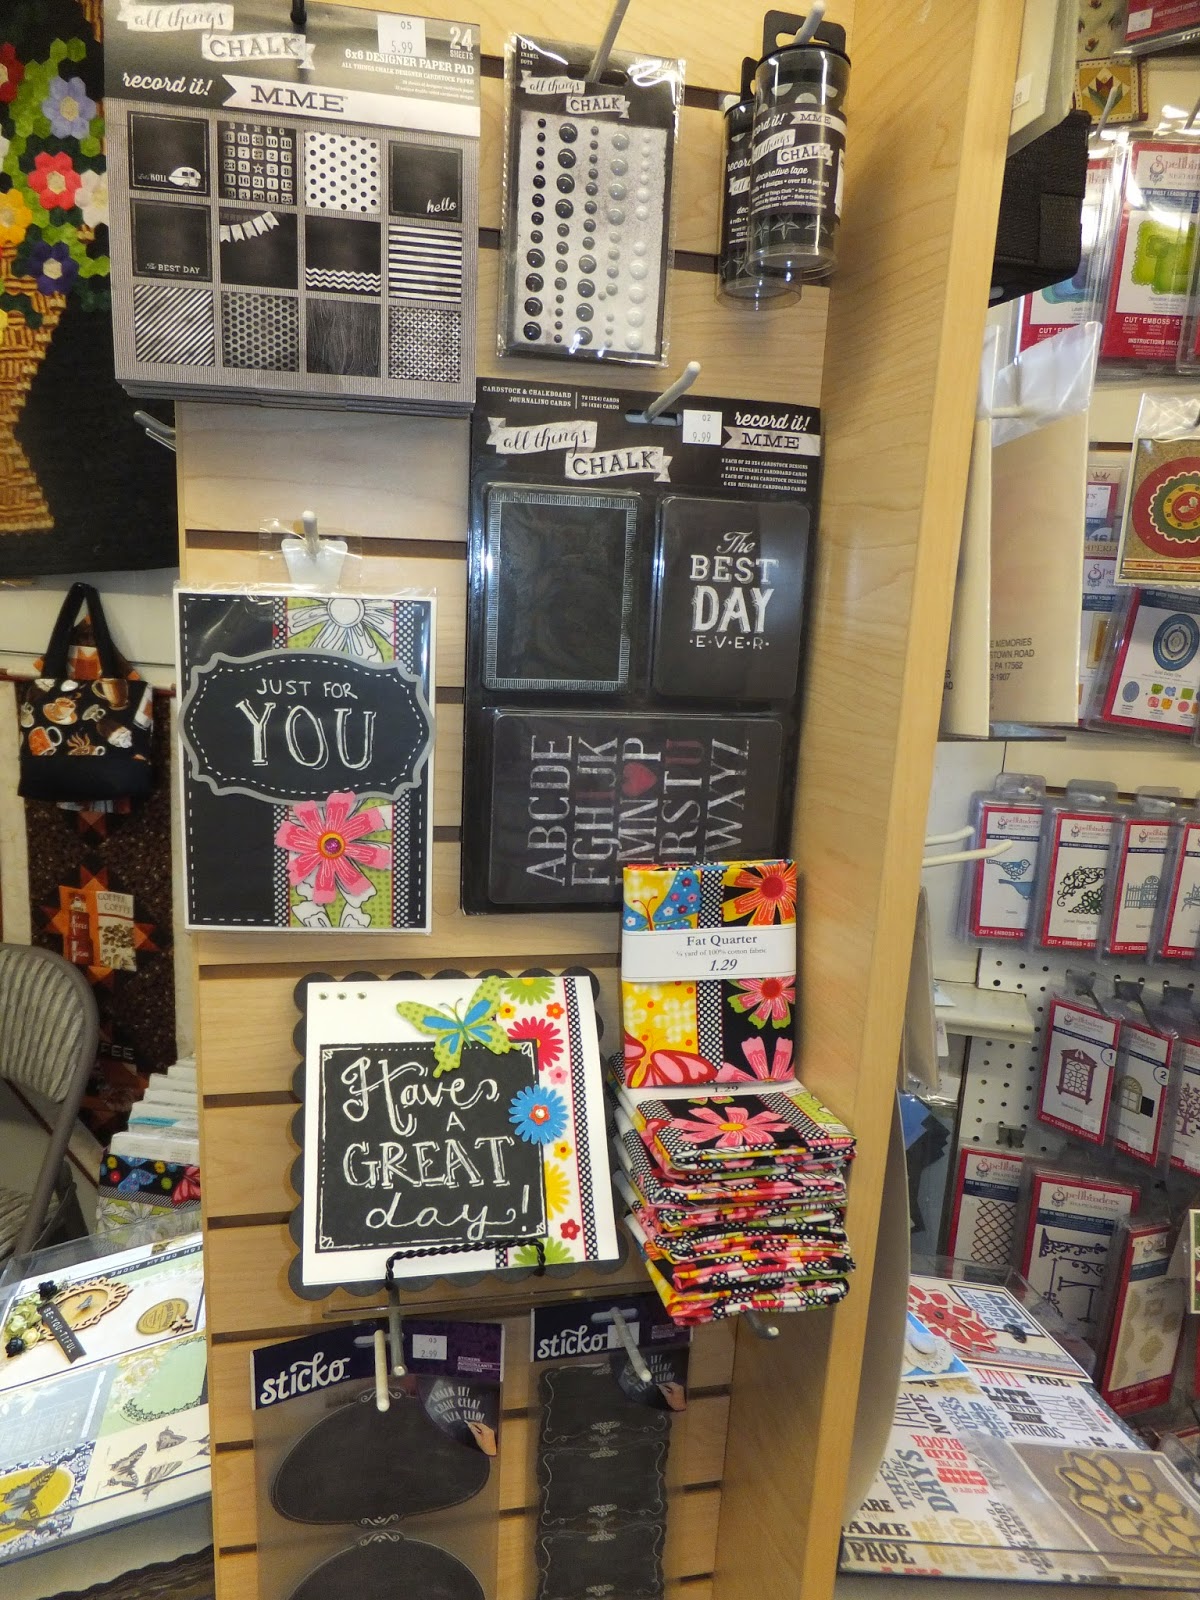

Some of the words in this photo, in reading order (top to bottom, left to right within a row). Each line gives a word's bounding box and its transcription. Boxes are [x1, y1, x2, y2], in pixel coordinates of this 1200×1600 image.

[134, 11, 162, 27] all
[167, 5, 225, 38] things
[400, 20, 412, 30] 05
[208, 36, 297, 59] CHALK
[391, 40, 414, 54] 5.99
[449, 26, 474, 52] 24
[344, 48, 364, 60] 6x6
[366, 51, 417, 67] DESIGNER
[420, 58, 452, 73] PAPER
[454, 63, 474, 75] PAD
[449, 49, 474, 60] SHEETS
[122, 72, 187, 94] record
[188, 78, 214, 96] it!
[354, 63, 374, 72] THINGS
[374, 66, 394, 74] CHALK
[395, 68, 423, 78] DESIGNER
[423, 72, 455, 82] CARDSTOCK
[456, 78, 474, 86] PAPER
[529, 79, 544, 92] all
[548, 76, 580, 98] things
[250, 85, 345, 114] MME
[570, 97, 621, 112] CHALK
[800, 113, 832, 124] MME
[790, 166, 808, 176] tape
[426, 198, 458, 214] hello
[158, 264, 181, 274] BEST
[183, 265, 201, 274] DAY
[1142, 316, 1171, 325] EMBOSS
[1128, 338, 1166, 346] INSTRUCTIONS
[482, 386, 521, 394] CARDSTOCK
[528, 389, 572, 398] CHALKBOARD
[508, 396, 549, 406] JOURNALING
[735, 411, 788, 429] record
[792, 414, 812, 431] it!
[503, 430, 530, 448] all
[534, 427, 590, 458] things
[692, 431, 712, 444] 9.99
[742, 432, 800, 450] MME
[572, 450, 655, 477] CHALK
[716, 531, 756, 554] The
[690, 555, 779, 584] BEST
[691, 585, 774, 634] DAY
[995, 638, 1032, 648] MEMORIES
[1014, 649, 1035, 658] ROAD
[994, 662, 1002, 670] PA
[256, 678, 312, 696] JUST
[323, 682, 358, 700] FOR
[235, 698, 377, 770] YOU
[687, 935, 706, 946] Fat
[710, 934, 758, 946] Quarter
[708, 958, 738, 972] 1.29
[340, 1056, 500, 1137] Have
[446, 1111, 466, 1132] A
[342, 1136, 516, 1190] GREAT
[1056, 1186, 1120, 1206] Spellbinders
[365, 1184, 530, 1240] day!
[537, 1326, 608, 1359] sticko
[420, 1350, 438, 1358] 2.99
[258, 1350, 351, 1405] sticko
[908, 1393, 952, 1435] NOTE
[1008, 1422, 1066, 1440] FRIENDS
[895, 1449, 960, 1514] DAYS
[847, 1521, 912, 1537] AME
[850, 1542, 916, 1566] PAGE
